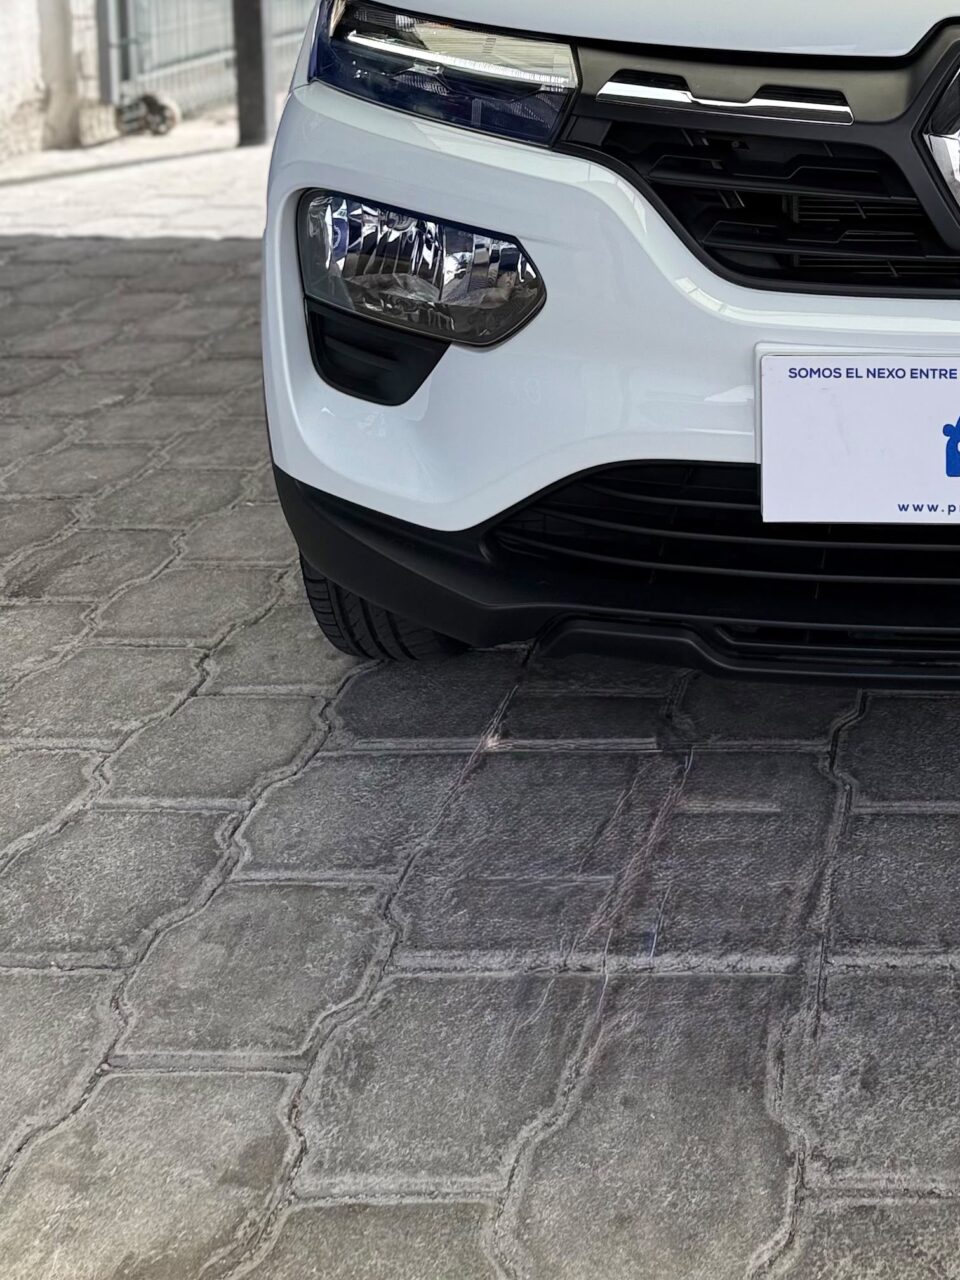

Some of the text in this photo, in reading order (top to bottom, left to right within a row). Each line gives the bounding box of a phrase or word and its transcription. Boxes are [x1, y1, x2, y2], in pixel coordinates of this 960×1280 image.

[788, 367, 843, 380] SOMOS
[845, 367, 864, 380] EL
[866, 367, 907, 380] NEXO
[909, 368, 958, 380] ENTRE
